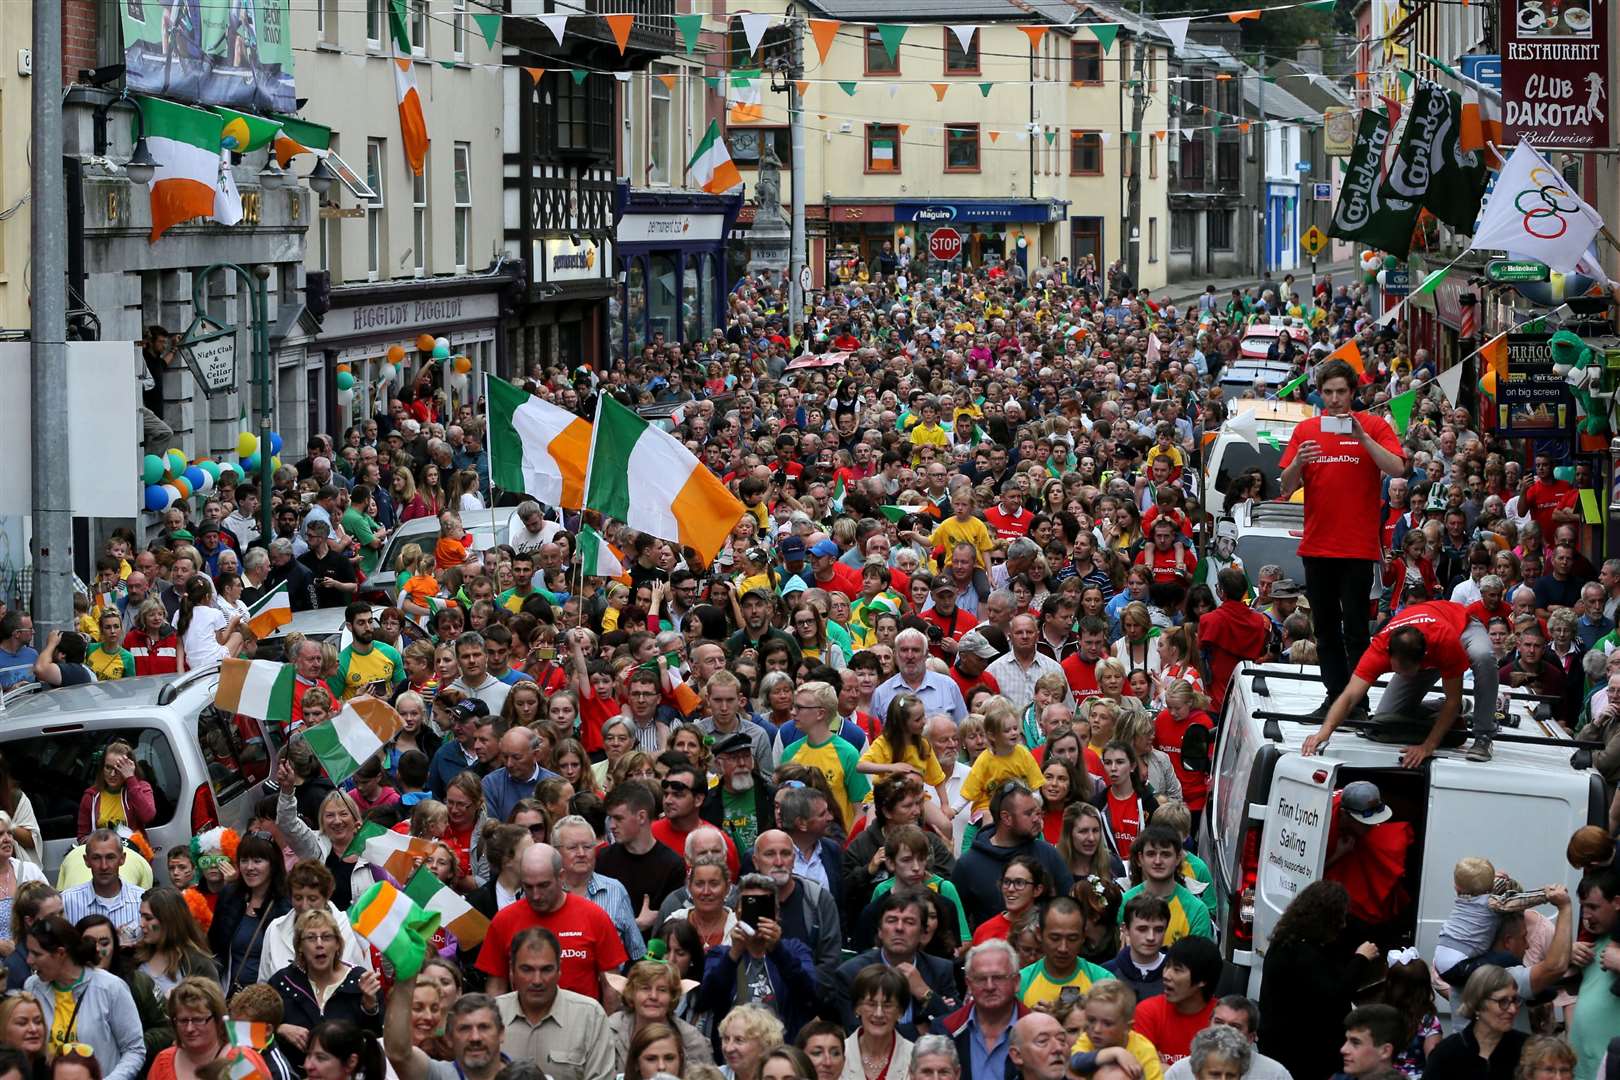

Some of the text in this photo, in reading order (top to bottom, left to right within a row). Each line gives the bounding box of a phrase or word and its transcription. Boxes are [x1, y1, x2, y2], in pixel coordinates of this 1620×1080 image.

[1508, 43, 1600, 60] RESTAURANT
[1525, 73, 1574, 99] CLUB
[1505, 101, 1590, 127] DAKOTA
[1516, 130, 1594, 144] Budweiser
[920, 210, 950, 220] Maguire
[931, 238, 960, 251] STOP
[1507, 264, 1538, 272] Heineken
[414, 298, 463, 322] PIGGILDY
[197, 345, 233, 360] Night Club
[209, 362, 227, 371] New
[206, 368, 233, 380] Cellar
[213, 377, 228, 385] Bar
[1547, 374, 1563, 382] Sport
[1518, 388, 1531, 398] big
[1277, 797, 1319, 828] Finn Lynch
[1279, 827, 1307, 858] Sailing
[1269, 851, 1284, 868] Proudly
[1284, 859, 1306, 876] supported
